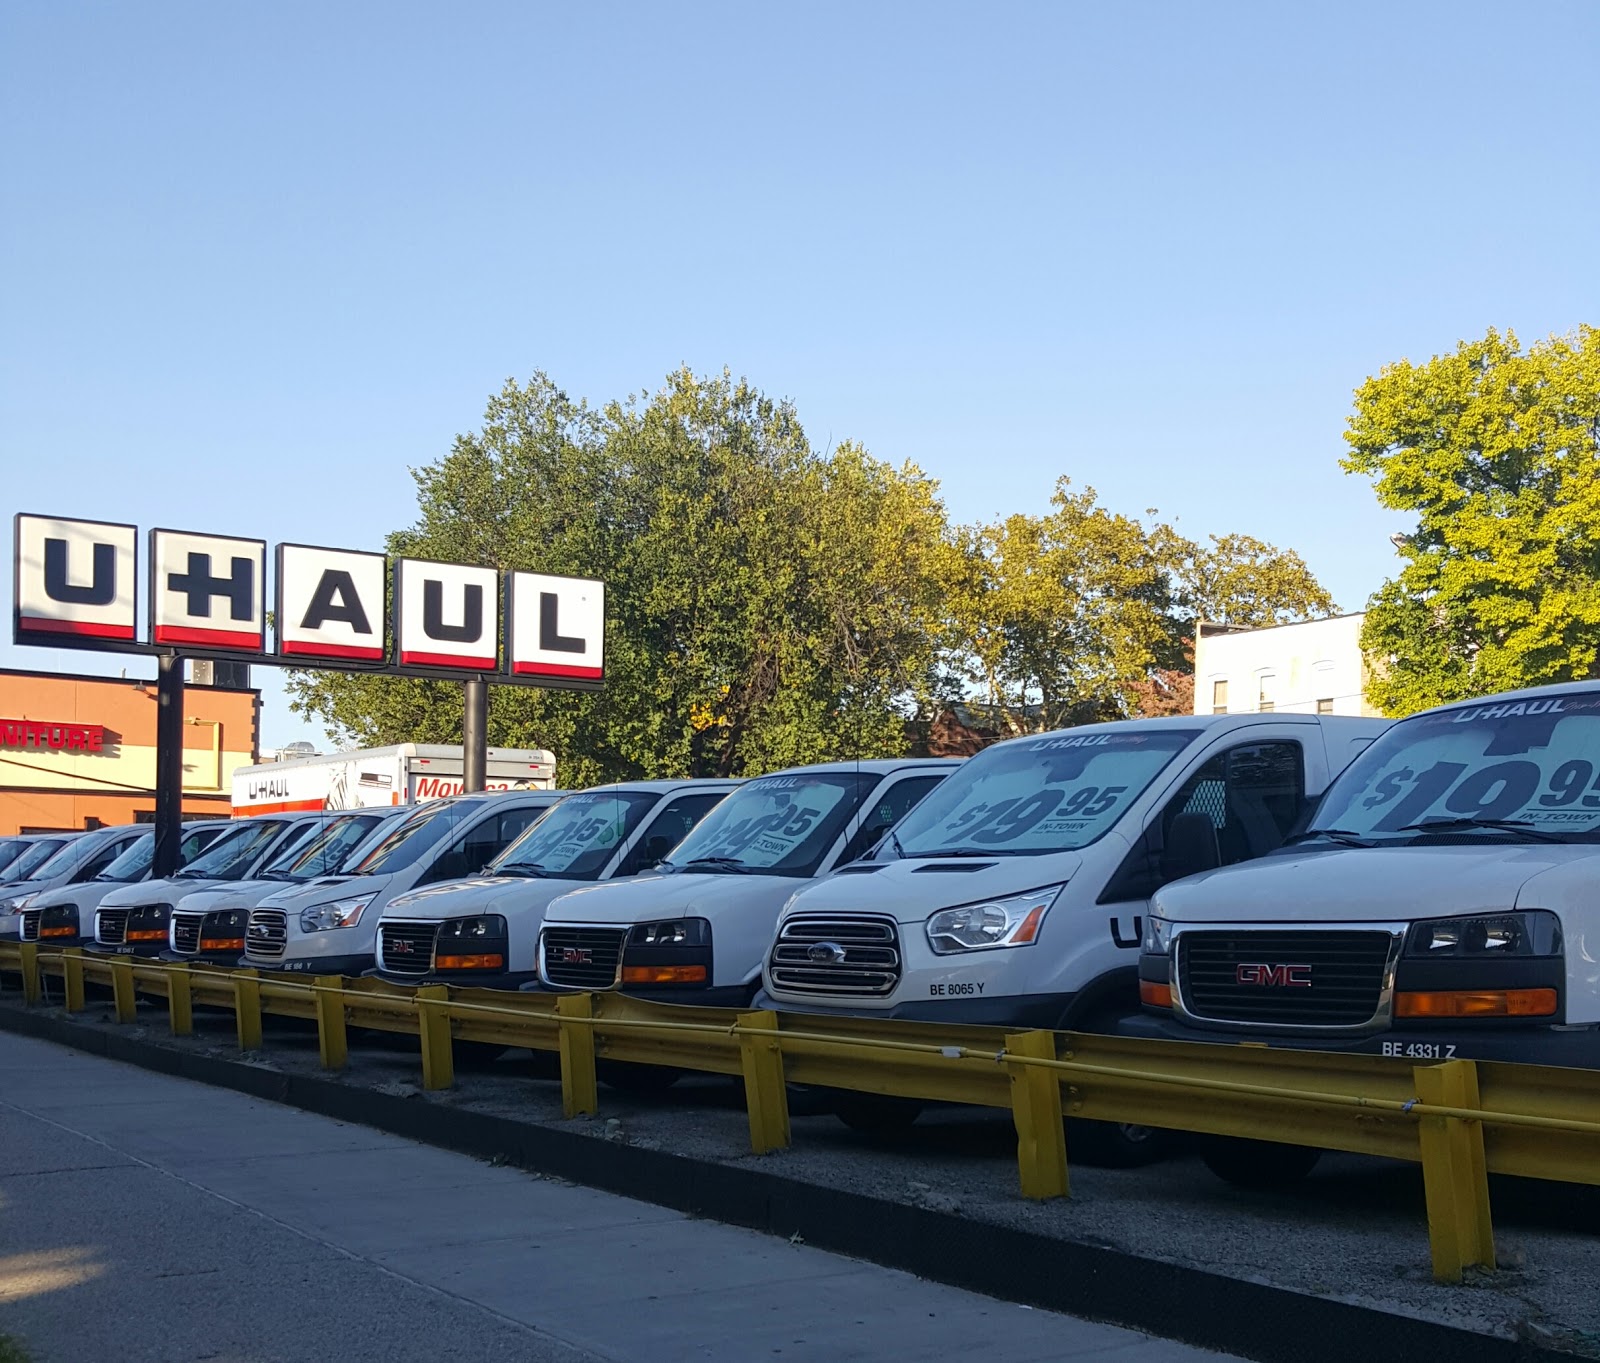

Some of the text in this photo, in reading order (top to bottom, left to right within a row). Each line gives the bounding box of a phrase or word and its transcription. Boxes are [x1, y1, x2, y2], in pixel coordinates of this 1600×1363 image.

[1453, 699, 1564, 723] U-HAUL
[1029, 734, 1112, 752] U-HAUL
[249, 778, 290, 799] U-HAUL
[1236, 963, 1312, 987] GMC
[930, 982, 985, 996] BE 8065 Y
[1382, 1041, 1457, 1059] BE 4331 Z
